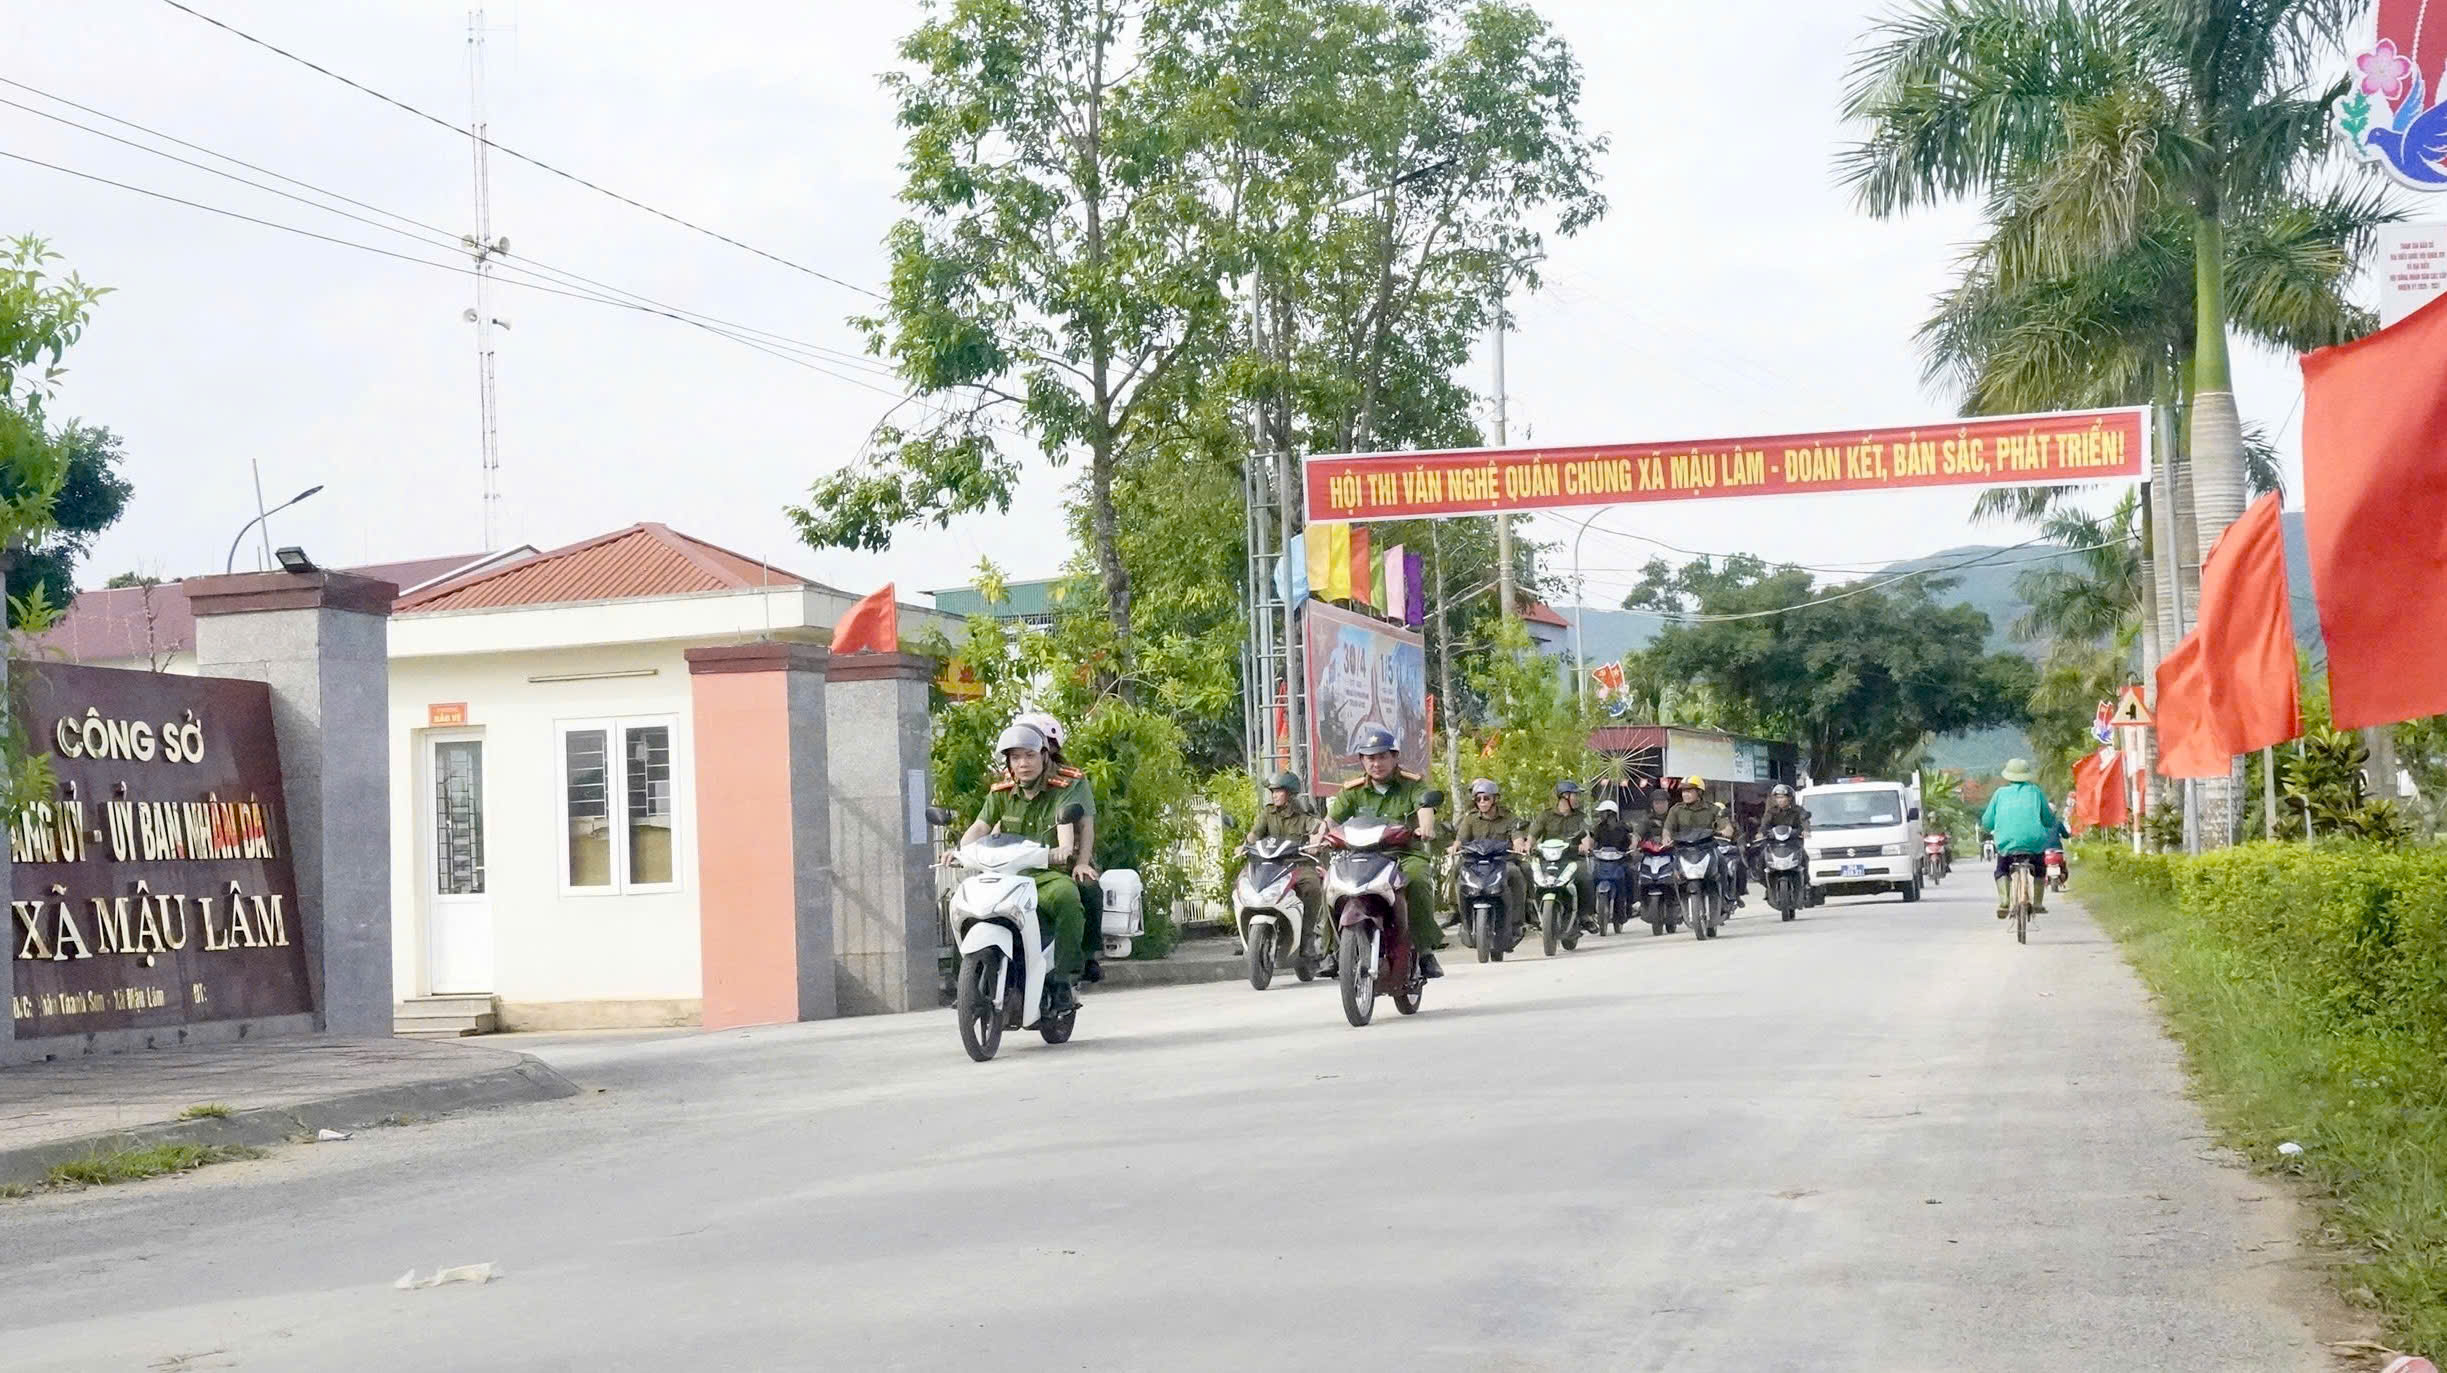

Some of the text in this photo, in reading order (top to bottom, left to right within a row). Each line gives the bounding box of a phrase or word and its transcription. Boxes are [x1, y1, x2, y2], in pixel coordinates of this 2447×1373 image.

[1330, 469, 1362, 516] HỘI
[1367, 473, 1398, 507] THI
[1402, 464, 1443, 505] VĂN
[1447, 460, 1500, 508] NGHỆ
[1565, 453, 1632, 496] CHÚNG
[1638, 450, 1665, 491] XÃ
[1670, 448, 1716, 497] MẬU
[1721, 445, 1765, 487] LÂM
[1784, 441, 1841, 483] ĐOÀN
[1847, 434, 1888, 482] KẾT,
[1893, 432, 1937, 477] BẢN
[1943, 427, 1991, 476] SẮC,
[1996, 428, 2050, 472] PHÁT
[2055, 417, 2126, 467] TRIỂN!
[1343, 643, 1367, 678] 30/4
[1380, 653, 1394, 685] 1/5
[57, 707, 206, 764] CÔNG SỞ
[58, 780, 87, 862] ỦY
[108, 780, 137, 862] ỦY
[139, 800, 185, 861] BAN
[183, 791, 242, 860] NHÂN
[240, 791, 280, 859] DÂN
[12, 880, 290, 968] XÃ MẬU LÂM
